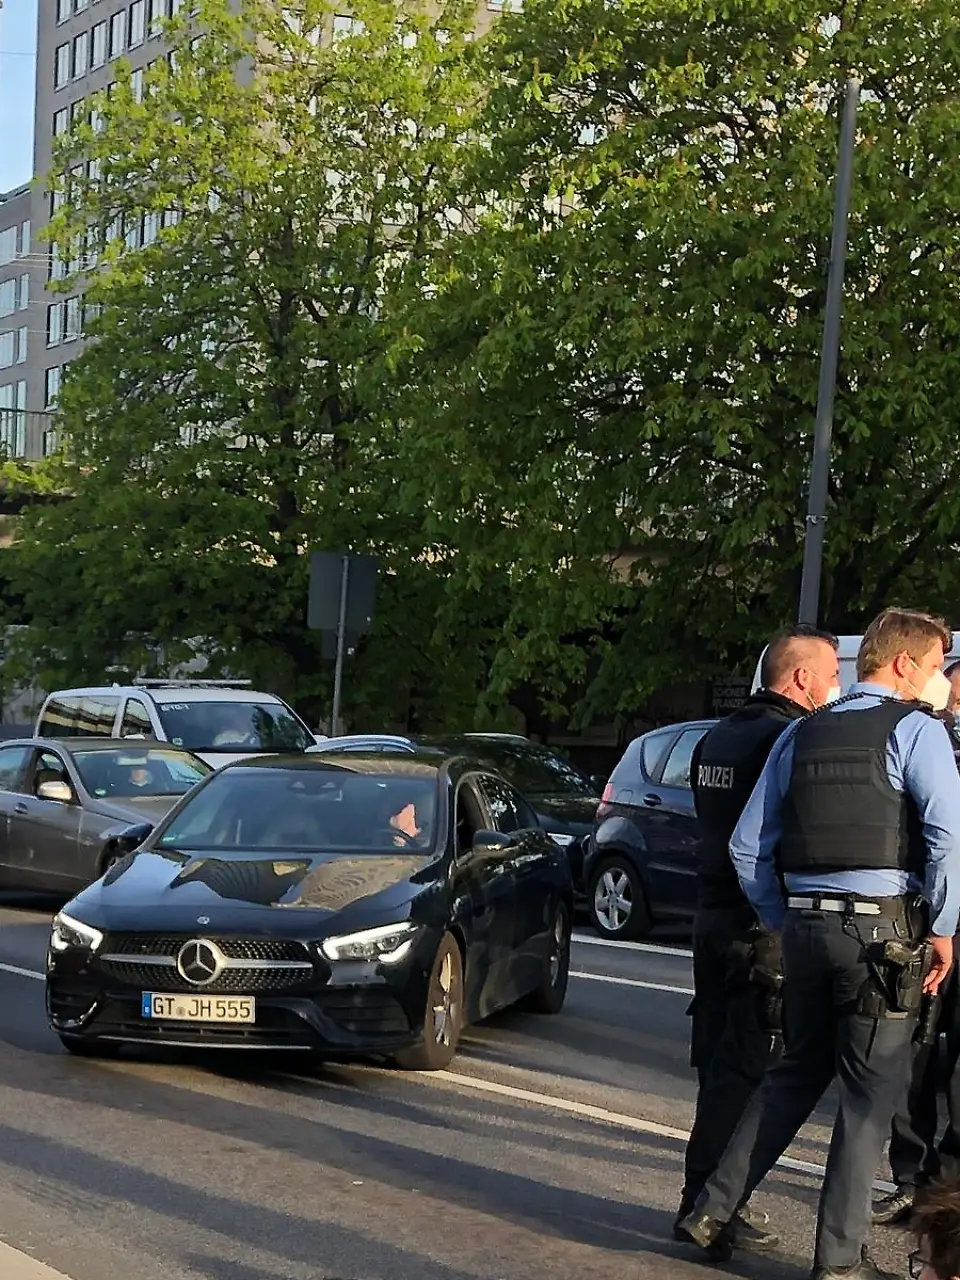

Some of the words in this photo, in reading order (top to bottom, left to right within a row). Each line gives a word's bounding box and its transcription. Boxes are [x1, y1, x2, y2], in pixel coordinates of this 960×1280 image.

[698, 765, 734, 788] POLIZEI
[153, 997, 175, 1015] GT
[188, 999, 212, 1017] JH
[216, 1000, 251, 1018] 555
